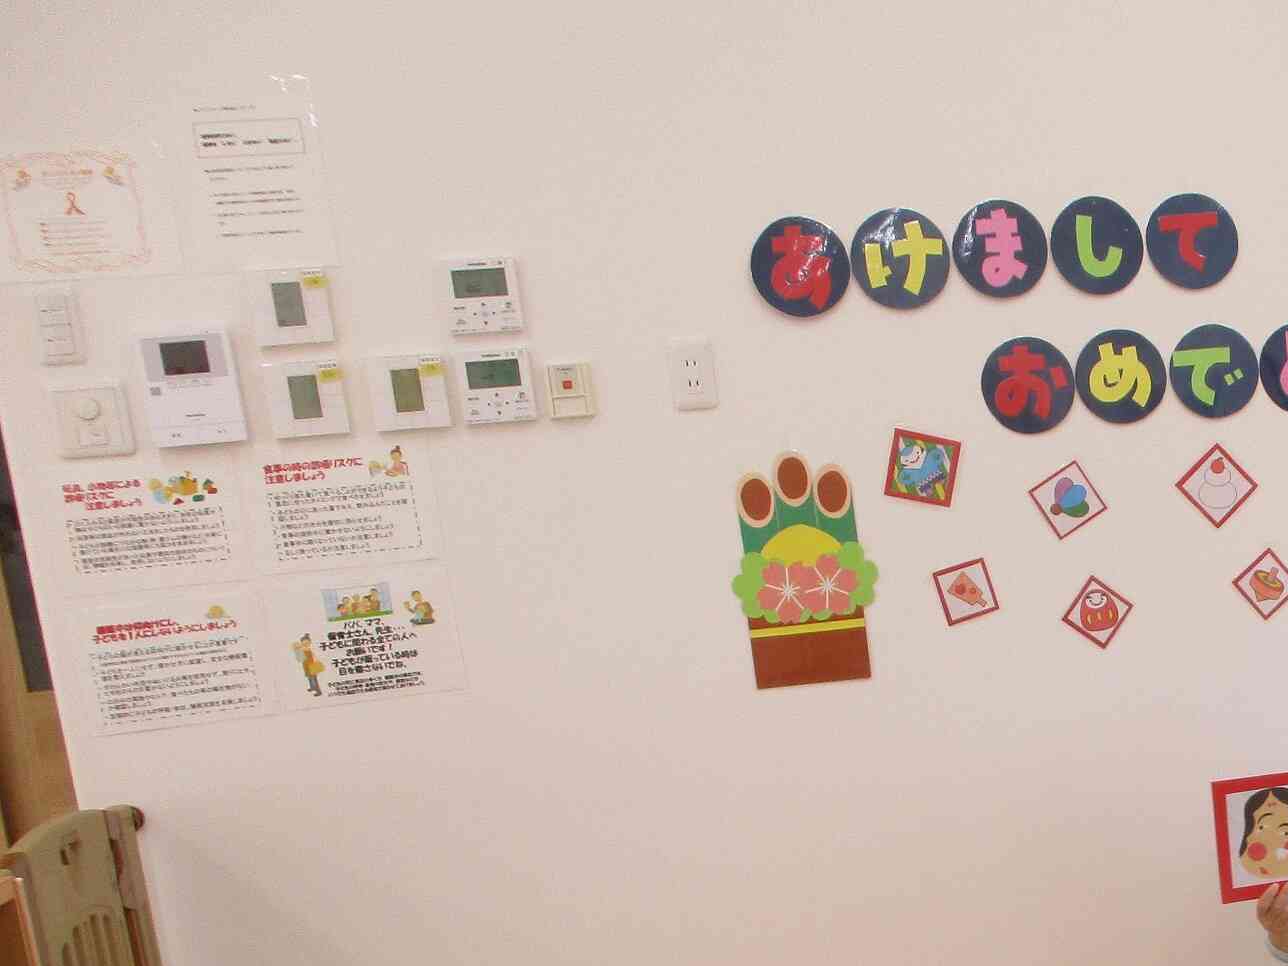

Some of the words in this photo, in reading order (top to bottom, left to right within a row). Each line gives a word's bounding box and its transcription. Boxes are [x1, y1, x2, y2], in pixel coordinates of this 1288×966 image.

[770, 208, 1219, 310] あけまして
